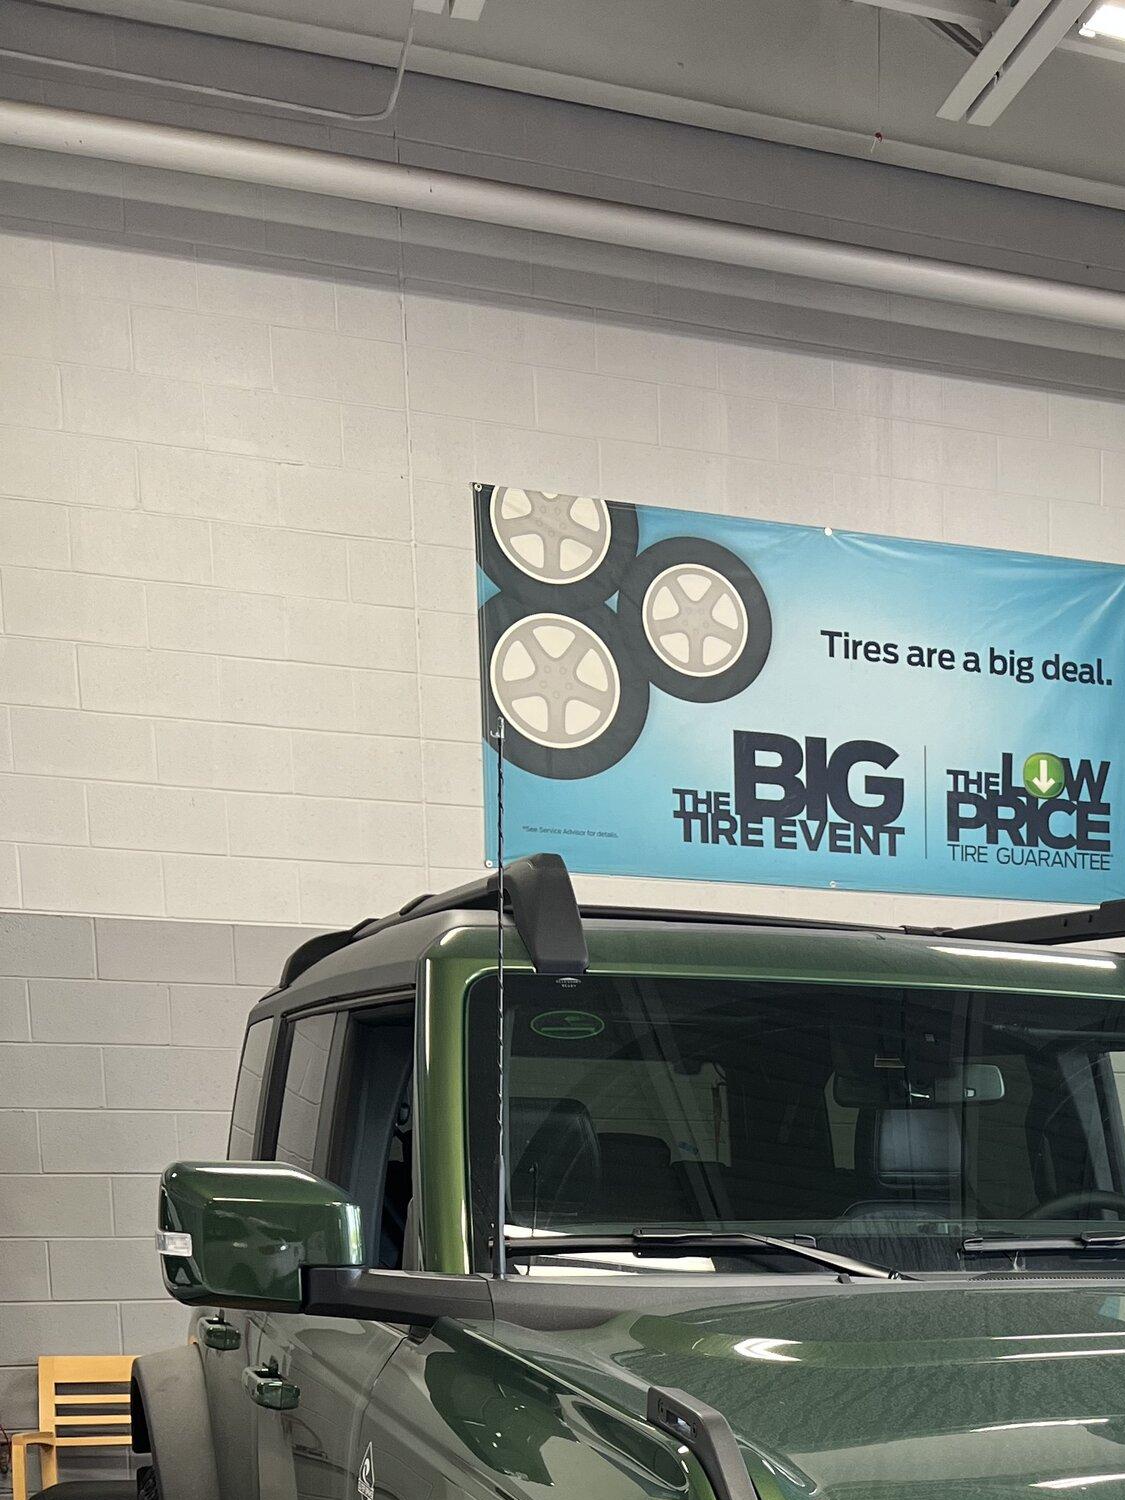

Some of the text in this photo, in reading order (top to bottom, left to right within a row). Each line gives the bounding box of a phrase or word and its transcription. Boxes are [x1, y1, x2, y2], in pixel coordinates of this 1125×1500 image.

[820, 629, 1113, 686] Tires are a big deal.
[672, 729, 905, 826] THE BIG
[946, 768, 1000, 796] THE
[673, 810, 906, 857] TIRE EVENT
[946, 790, 1111, 853] PRICE
[947, 843, 1112, 871] TIRE GUARANTEE
